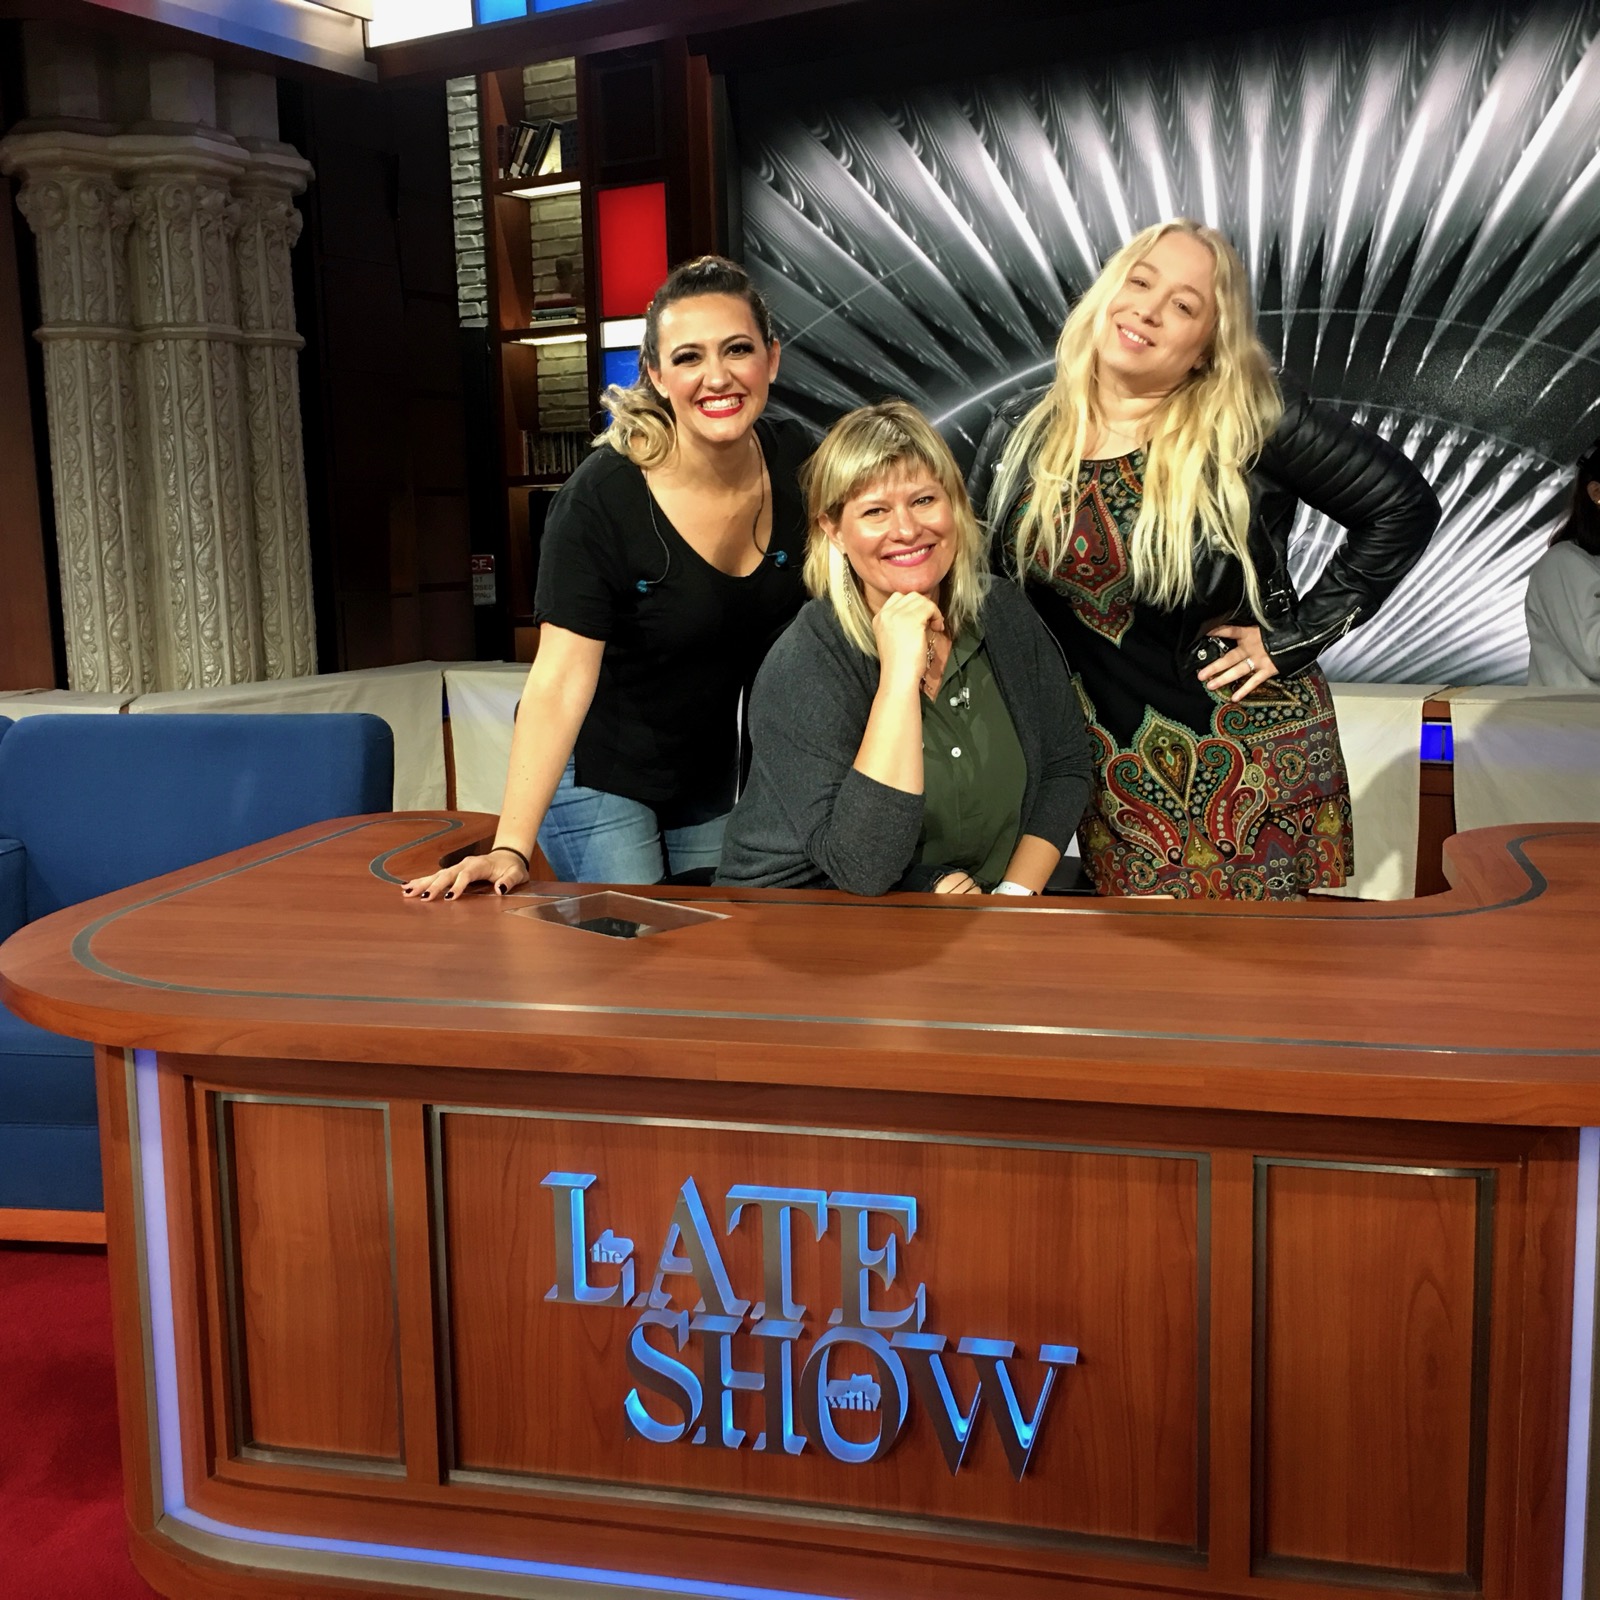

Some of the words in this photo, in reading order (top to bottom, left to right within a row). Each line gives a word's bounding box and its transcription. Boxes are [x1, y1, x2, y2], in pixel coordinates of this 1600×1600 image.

[540, 1171, 928, 1333] LATE
[591, 1241, 624, 1264] the
[623, 1308, 1079, 1483] SHOW
[824, 1389, 875, 1412] with
